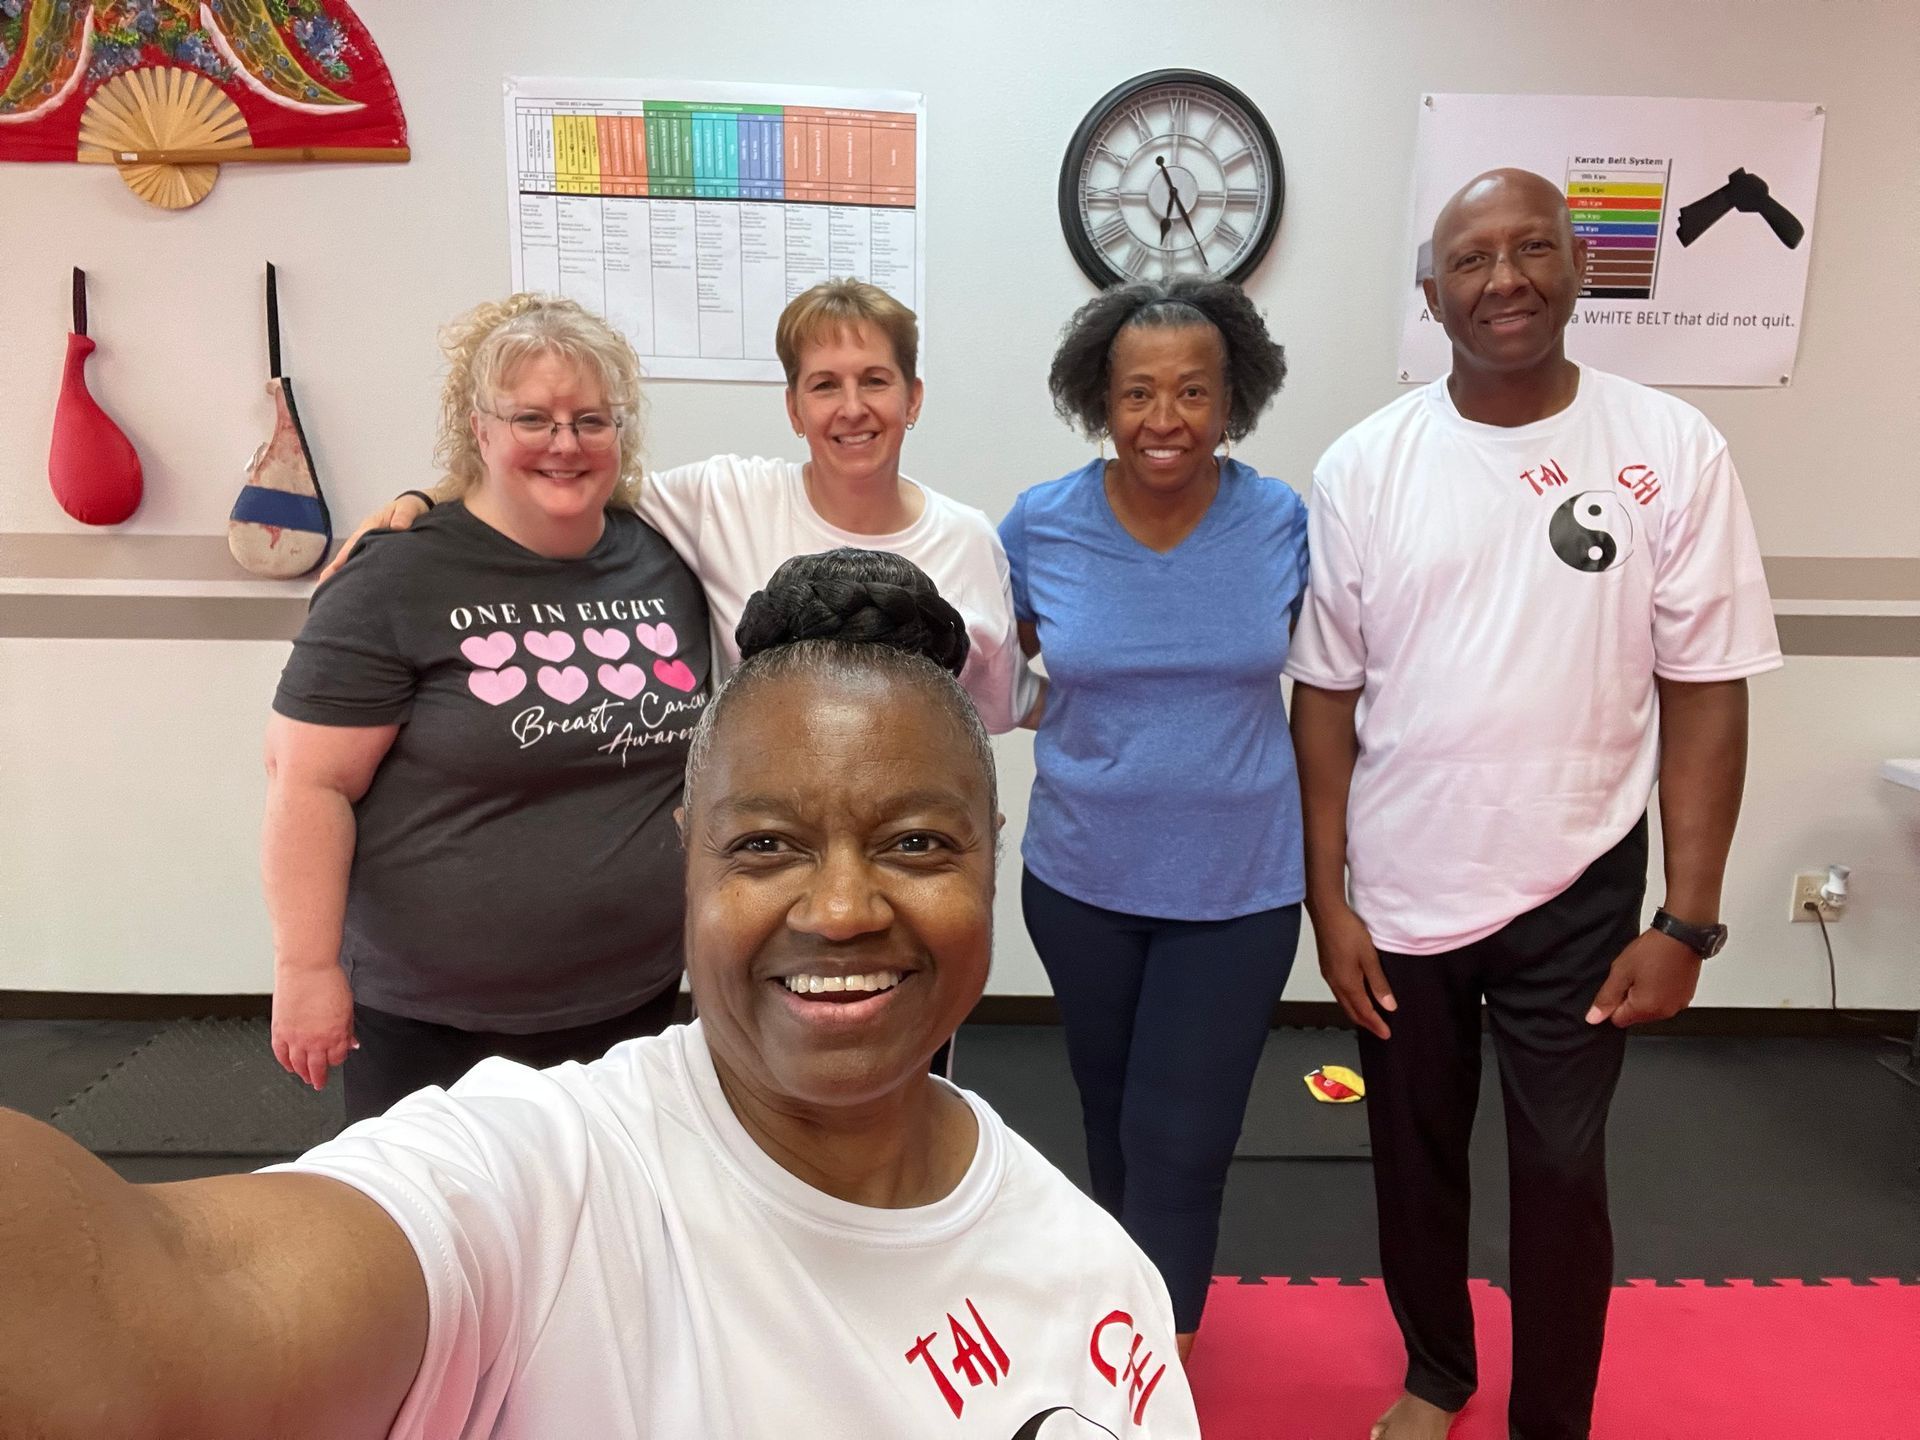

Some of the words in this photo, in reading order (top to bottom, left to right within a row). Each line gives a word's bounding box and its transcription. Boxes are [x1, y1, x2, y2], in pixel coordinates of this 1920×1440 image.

[1169, 98, 1189, 134] XII
[1575, 156, 1605, 164] Karate
[1608, 156, 1627, 165] Belt
[1628, 157, 1663, 167] System
[1420, 309, 1430, 323] A
[1570, 314, 1579, 324] a
[1585, 311, 1632, 326] WHITE
[1637, 311, 1672, 327] BELT
[1673, 312, 1702, 327] that
[1706, 313, 1730, 328] did
[1733, 314, 1758, 328] not
[1763, 314, 1795, 332] quit.
[1519, 458, 1569, 496] TAI
[1617, 464, 1662, 506] CHI
[450, 603, 521, 631] ONE
[531, 603, 567, 624] IN
[576, 598, 668, 622] EIGHT
[511, 698, 625, 750] Breast
[904, 1296, 1011, 1420] TAI
[1089, 1309, 1167, 1426] CHI
